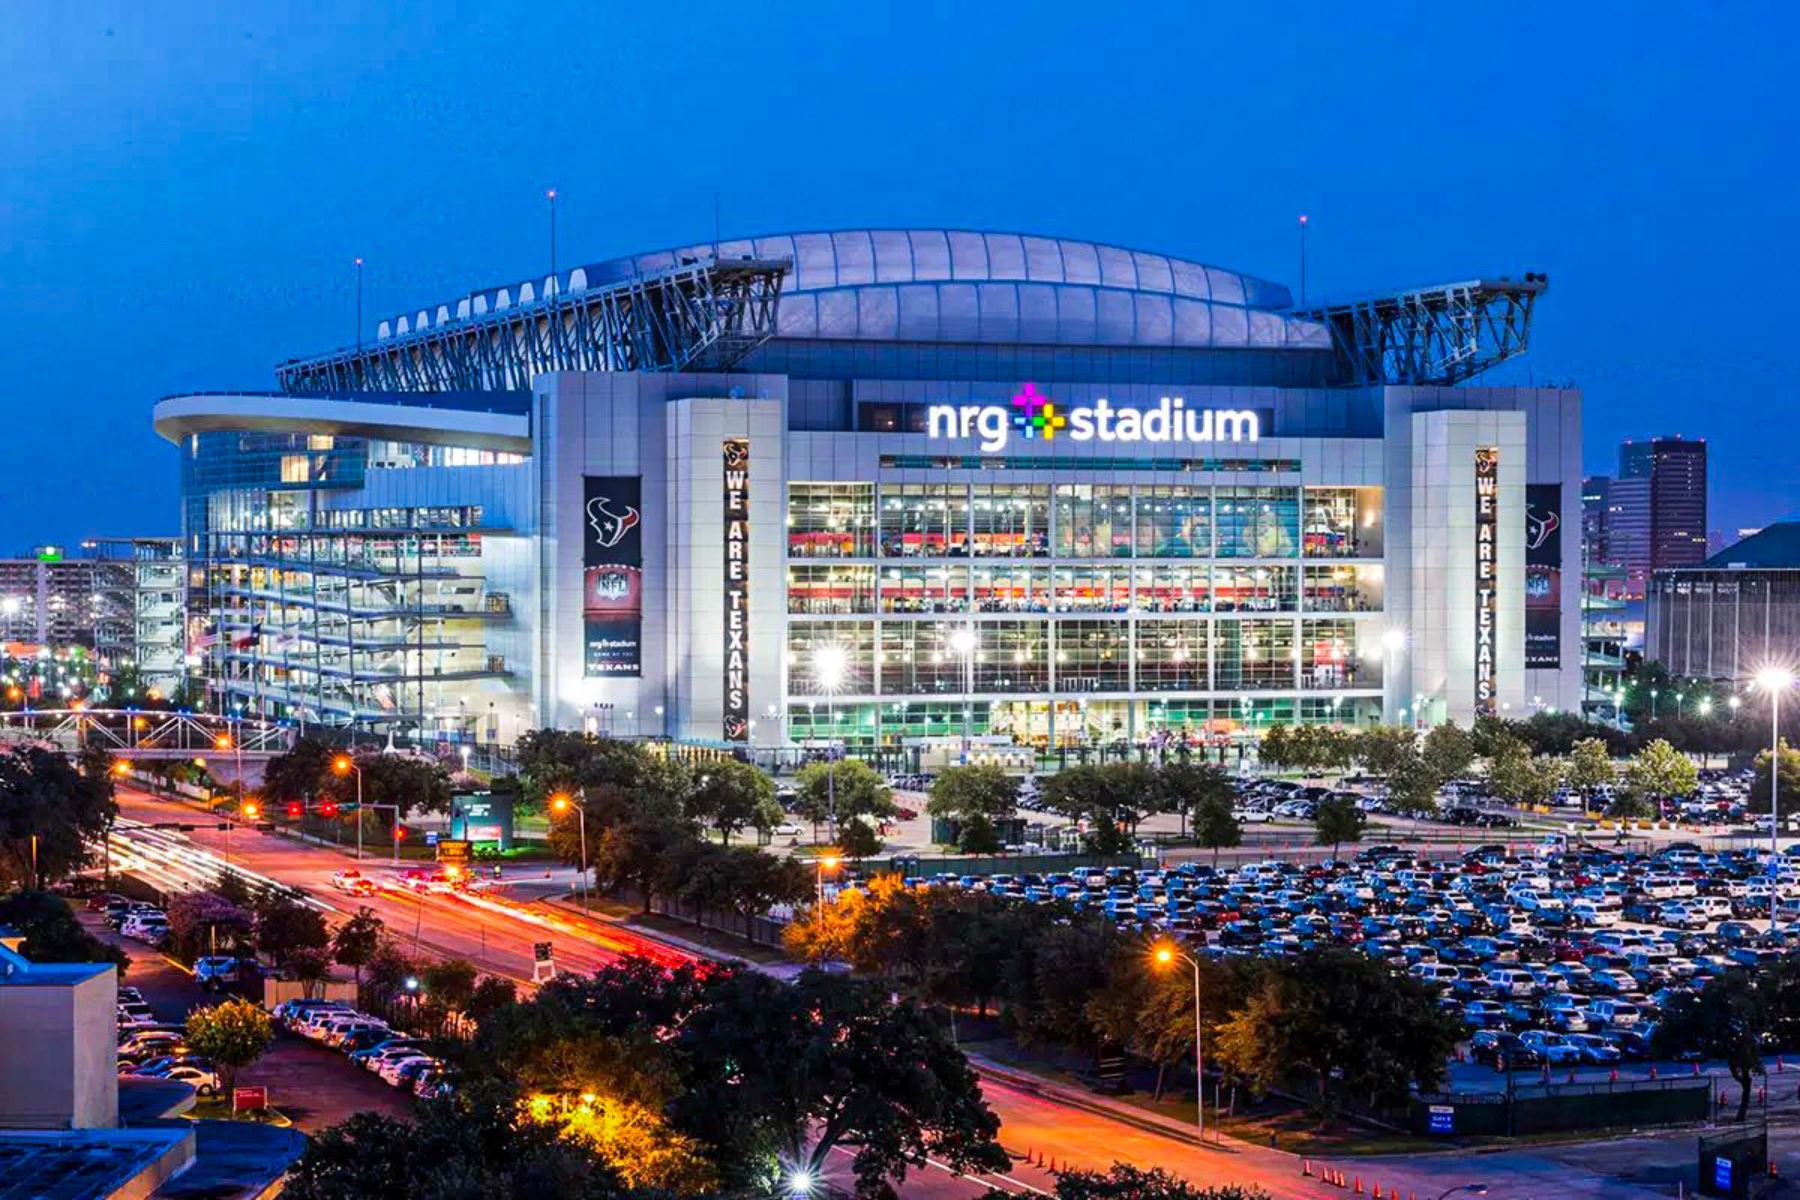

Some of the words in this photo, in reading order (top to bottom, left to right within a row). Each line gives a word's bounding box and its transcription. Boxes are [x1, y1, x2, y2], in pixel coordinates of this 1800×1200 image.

[928, 404, 1008, 452] nrg
[1069, 398, 1259, 442] stadium
[726, 470, 744, 510] WE
[1477, 476, 1494, 514] WE
[728, 521, 743, 580] ARE
[1479, 523, 1492, 579] ARE
[601, 580, 627, 592] NFL
[1526, 580, 1549, 591] NFL
[588, 663, 640, 671] TEXANS
[728, 590, 743, 710] TEXANS
[1478, 589, 1492, 700] TEXANS
